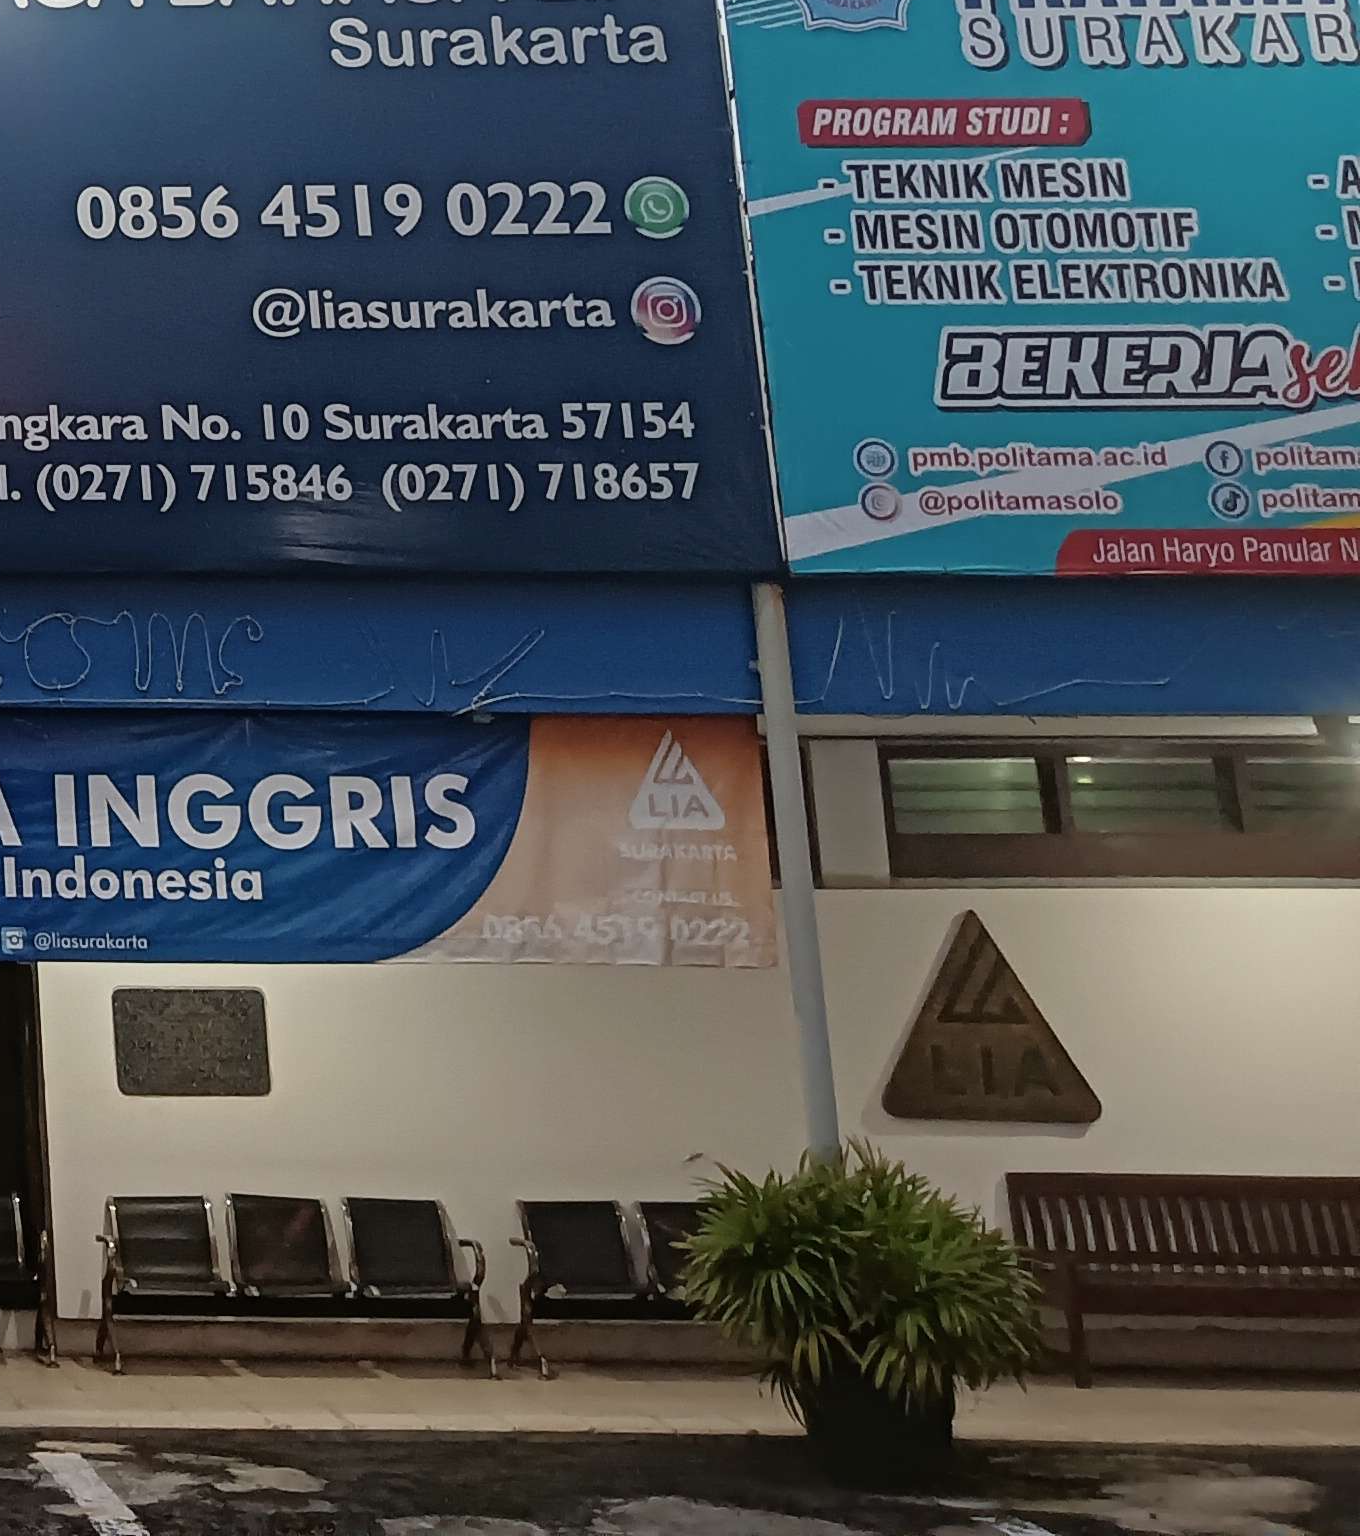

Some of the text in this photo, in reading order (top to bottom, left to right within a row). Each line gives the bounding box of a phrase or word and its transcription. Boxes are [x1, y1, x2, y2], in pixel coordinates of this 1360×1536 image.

[329, 14, 668, 68] Surakarta
[968, 13, 1349, 59] SURAKAR
[812, 107, 957, 138] PROGRAM
[966, 106, 1050, 136] STUDI
[846, 163, 989, 200] TEKNIK
[999, 161, 1127, 199] MESIN
[76, 181, 612, 241] 0856 4519 0222
[854, 212, 980, 250] MESIN
[993, 211, 1195, 250] OTOMOTIF
[859, 263, 1001, 301] TEKNIK
[1013, 260, 1286, 301] ELEKTRONIKA
[252, 287, 616, 338] @liasurakarta
[944, 331, 1282, 398] BEKERJA
[160, 403, 243, 442] No.
[261, 403, 310, 441] 10
[323, 403, 549, 441] Surakarta
[561, 401, 696, 440] 57154
[912, 443, 1360, 471] pmb.politama.ac.id politam
[36, 463, 177, 513] (0271)
[190, 463, 354, 502] 715846
[381, 462, 525, 512] (0271)
[537, 462, 700, 501] 718657
[918, 489, 1120, 516] @politamasolo
[1092, 537, 1156, 564] Jalan
[1162, 537, 1234, 568] Haryo
[1243, 536, 1332, 563] Panular
[53, 771, 477, 851] INGGRIS
[647, 795, 711, 821] LIA
[4, 855, 264, 903] Indonesia
[33, 930, 148, 952] @liasurakarta
